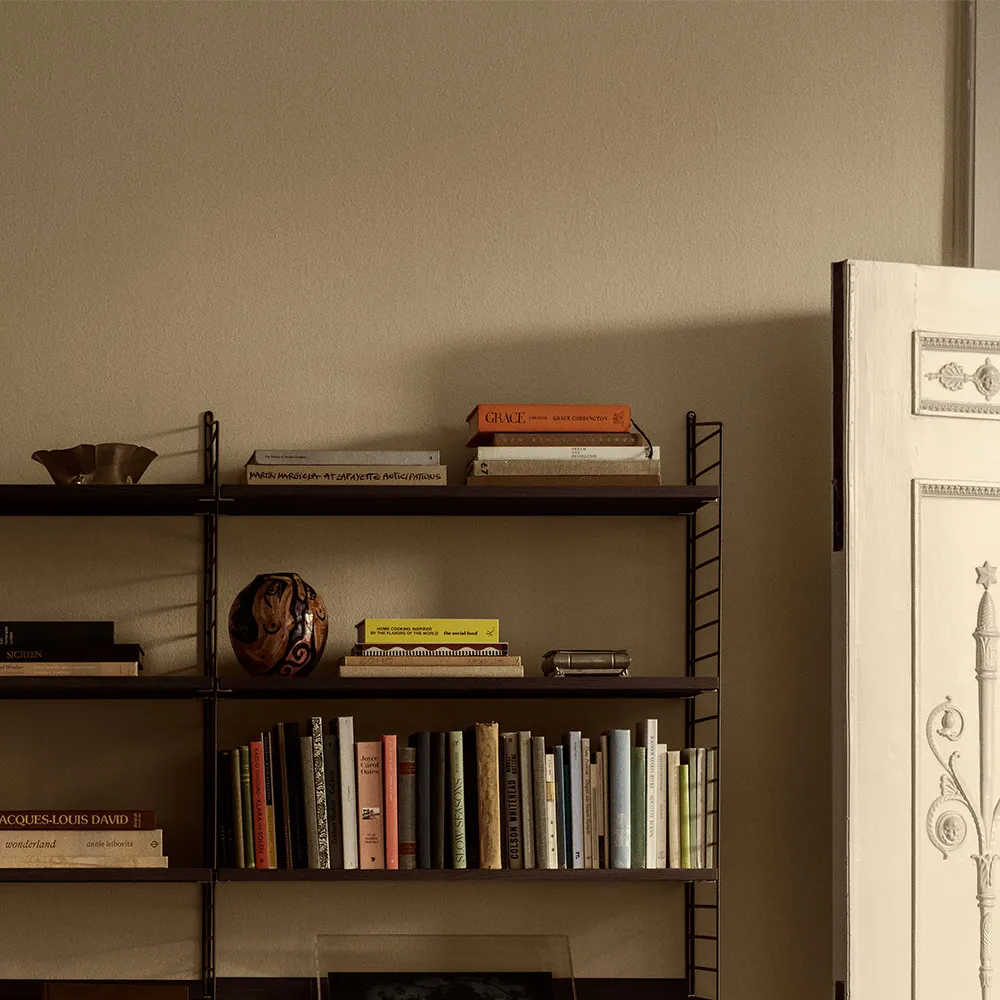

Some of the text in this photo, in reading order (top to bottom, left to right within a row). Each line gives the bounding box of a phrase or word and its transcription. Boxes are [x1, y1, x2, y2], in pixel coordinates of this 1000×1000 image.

[485, 412, 526, 424] GRACE
[250, 471, 276, 480] MARTIN
[323, 472, 336, 480] AT
[336, 472, 381, 481] LAFAYETTE
[382, 472, 442, 480] ANTICIPATIONS
[454, 777, 464, 828] SEASONS
[91, 814, 129, 825] DAVID
[507, 779, 519, 859] COLSON WHITEHEAD
[5, 839, 57, 849] wonderland
[455, 830, 464, 863] SLOW
